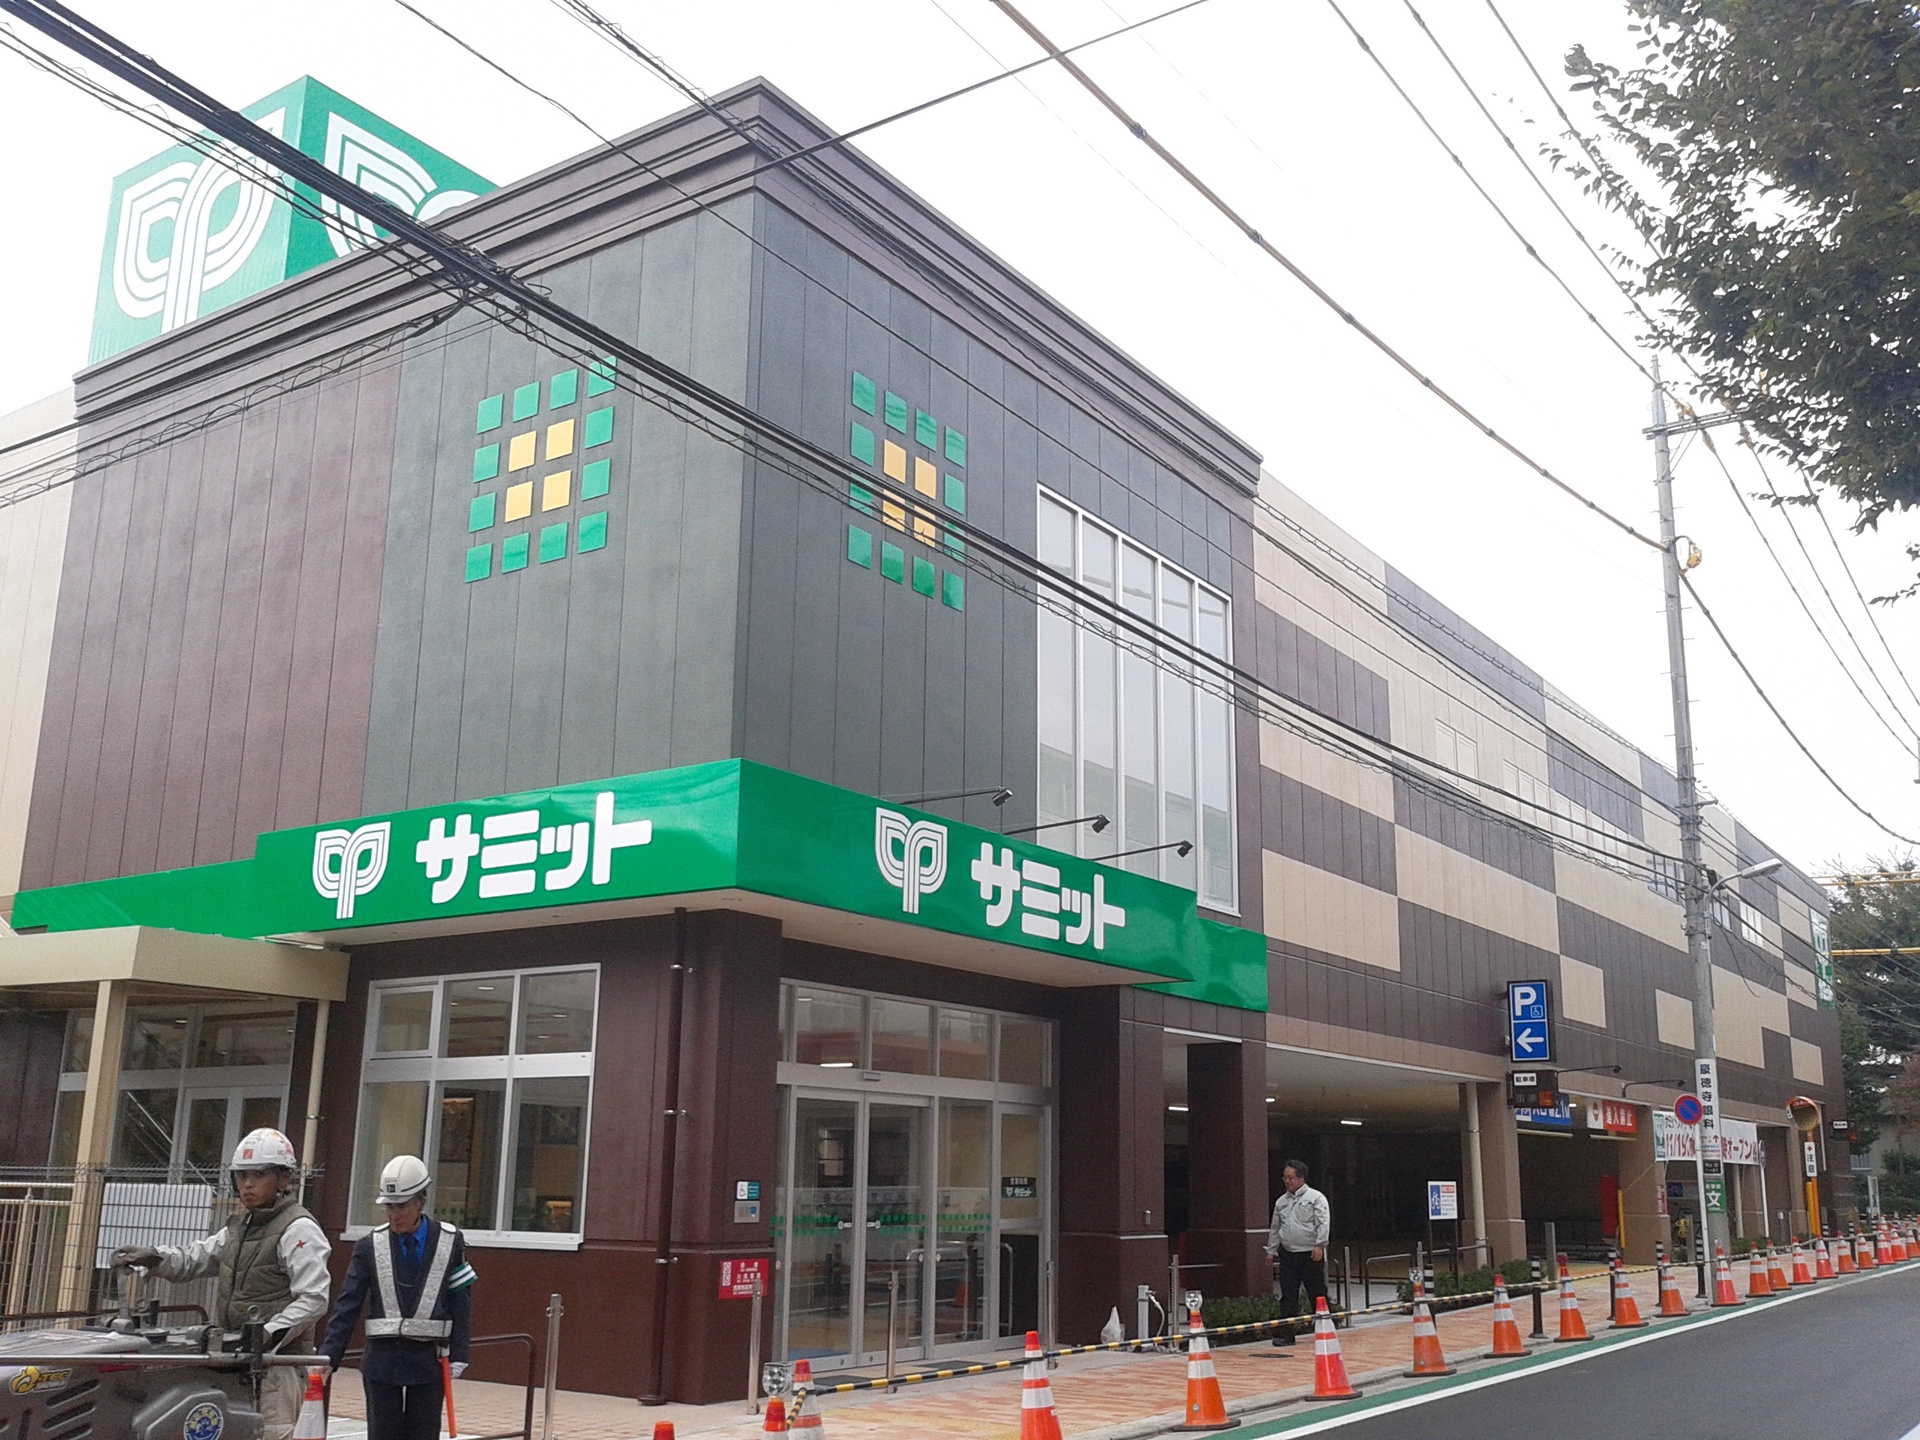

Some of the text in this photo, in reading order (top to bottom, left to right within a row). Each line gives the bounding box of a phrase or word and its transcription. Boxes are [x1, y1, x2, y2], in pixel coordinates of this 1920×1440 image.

[416, 790, 653, 905] サミット
[971, 842, 1126, 950] サミット
[1514, 986, 1537, 1016] P
[1700, 1063, 1714, 1129] 豪徳寺眼科
[1806, 1153, 1815, 1173] 注意
